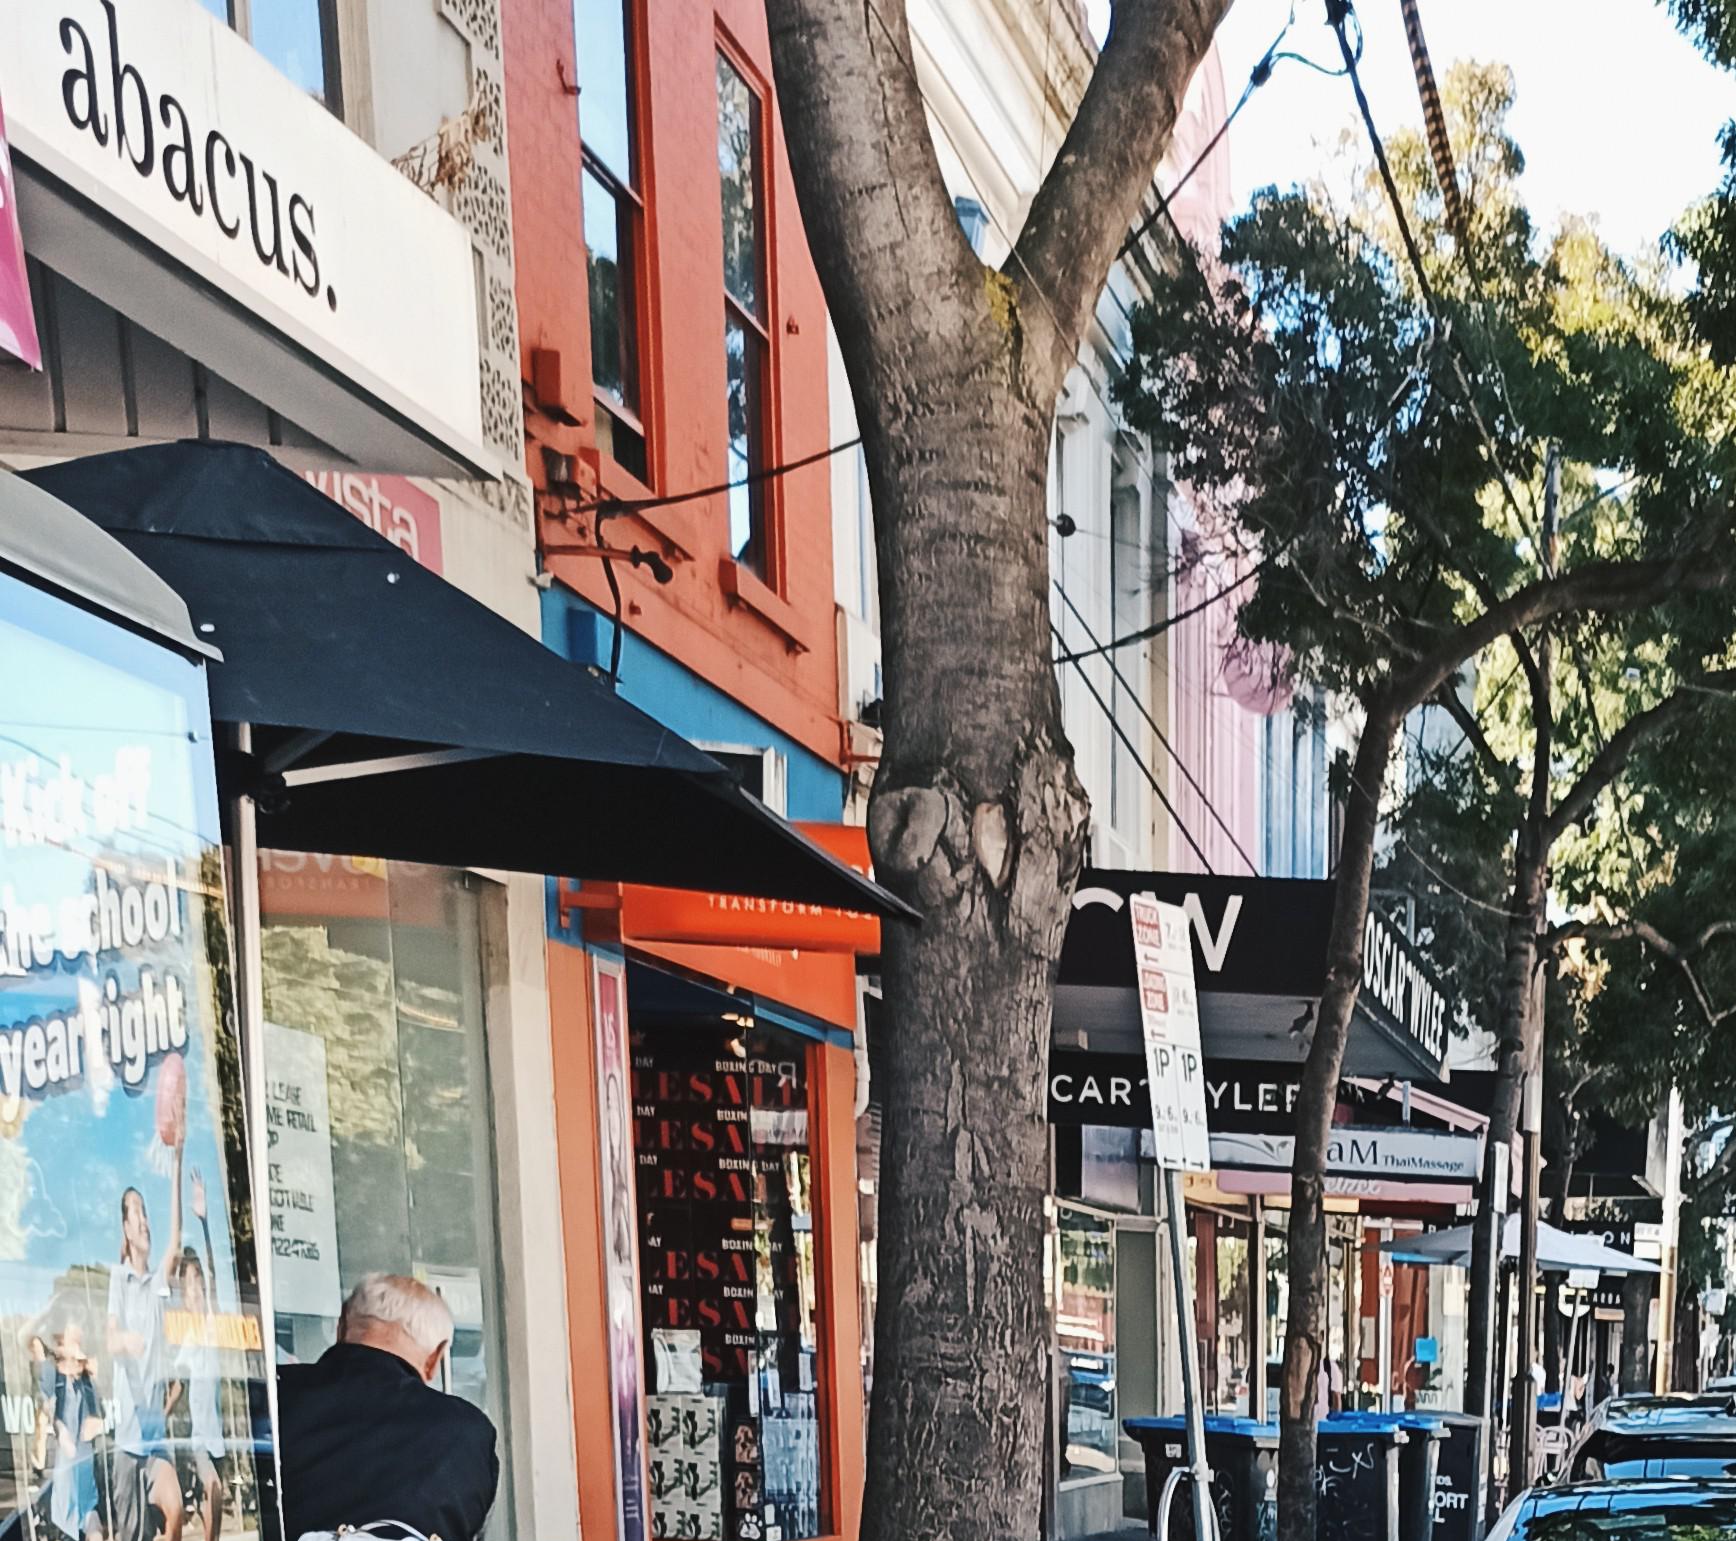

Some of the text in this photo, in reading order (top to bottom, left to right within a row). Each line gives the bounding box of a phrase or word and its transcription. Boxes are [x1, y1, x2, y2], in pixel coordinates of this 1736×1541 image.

[59, 0, 337, 313] abacus.
[1364, 911, 1406, 1025] OSCAR
[0, 971, 187, 1102] year right
[1154, 1047, 1169, 1078] 1P
[1182, 1052, 1197, 1083] 1P
[1051, 1074, 1131, 1106] CAR
[717, 1109, 748, 1122] BOXIN
[1327, 1138, 1378, 1166] aM
[648, 1236, 662, 1248] AY
[722, 1237, 753, 1251] BOXIN
[649, 1284, 664, 1296] AY
[724, 1285, 754, 1298] BOXIN
